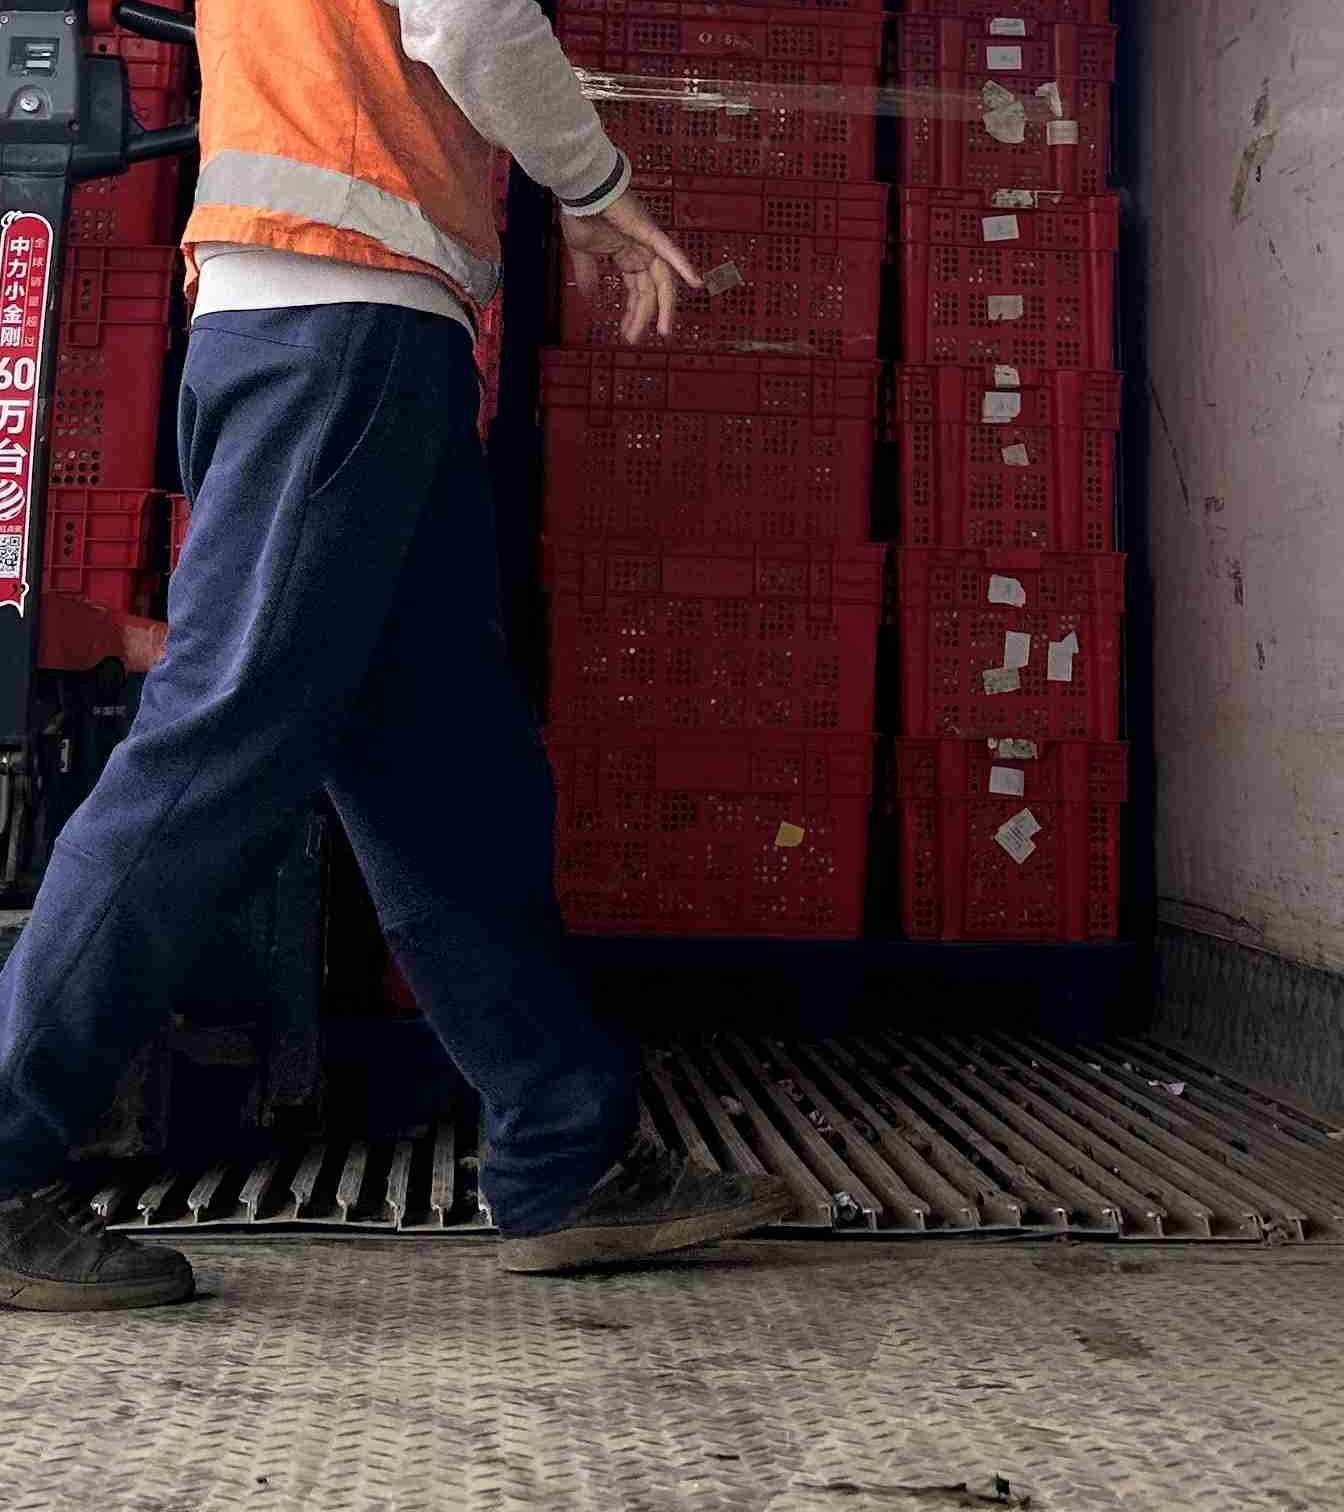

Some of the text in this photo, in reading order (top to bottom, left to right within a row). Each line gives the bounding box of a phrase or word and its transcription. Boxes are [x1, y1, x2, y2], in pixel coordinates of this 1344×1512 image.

[0, 236, 31, 347] 中力小金刚
